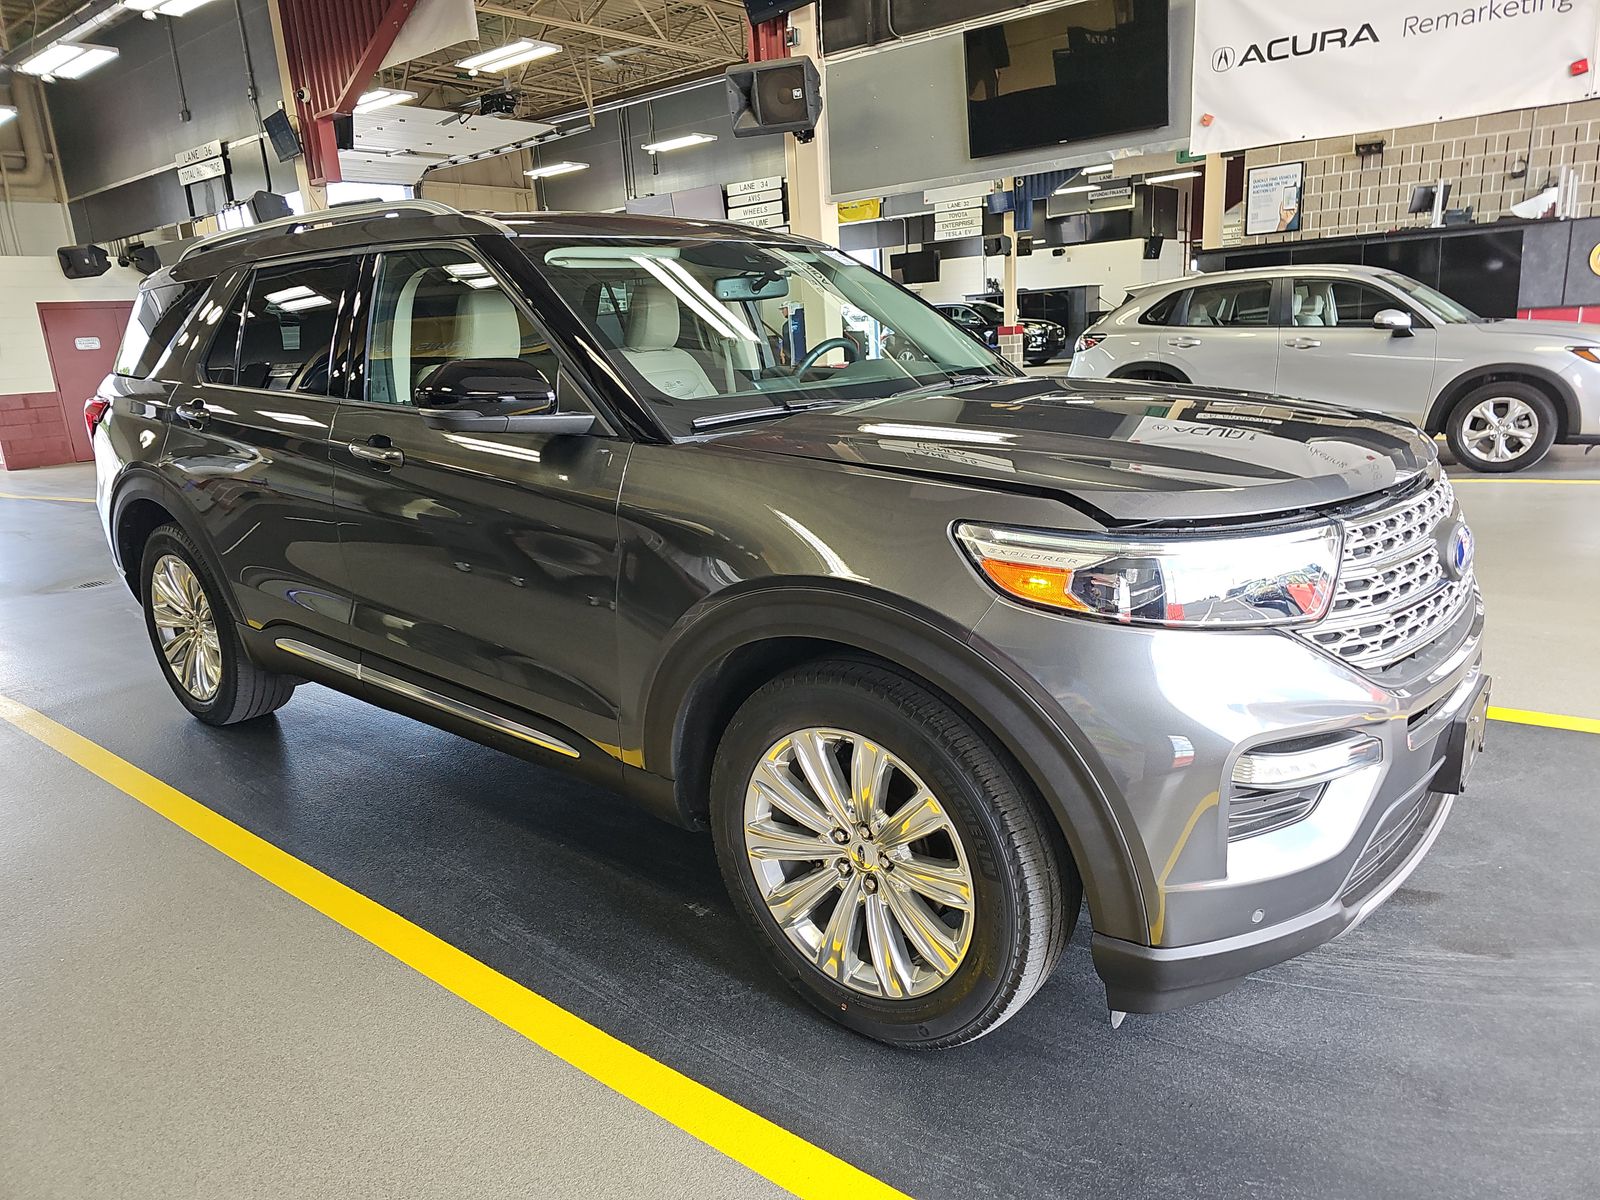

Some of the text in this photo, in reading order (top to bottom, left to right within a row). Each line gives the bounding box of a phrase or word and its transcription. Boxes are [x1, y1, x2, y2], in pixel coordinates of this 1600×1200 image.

[1238, 23, 1380, 67] ACURA
[183, 145, 213, 163] LANE 36
[181, 170, 196, 181] TOTAL
[740, 180, 769, 192] LANE 34
[748, 193, 761, 202] AVIS
[947, 201, 962, 209] LANE
[743, 206, 768, 216] WHEELS
[941, 220, 975, 229] ENTERPRISE
[987, 547, 1079, 565] EXPLORER
